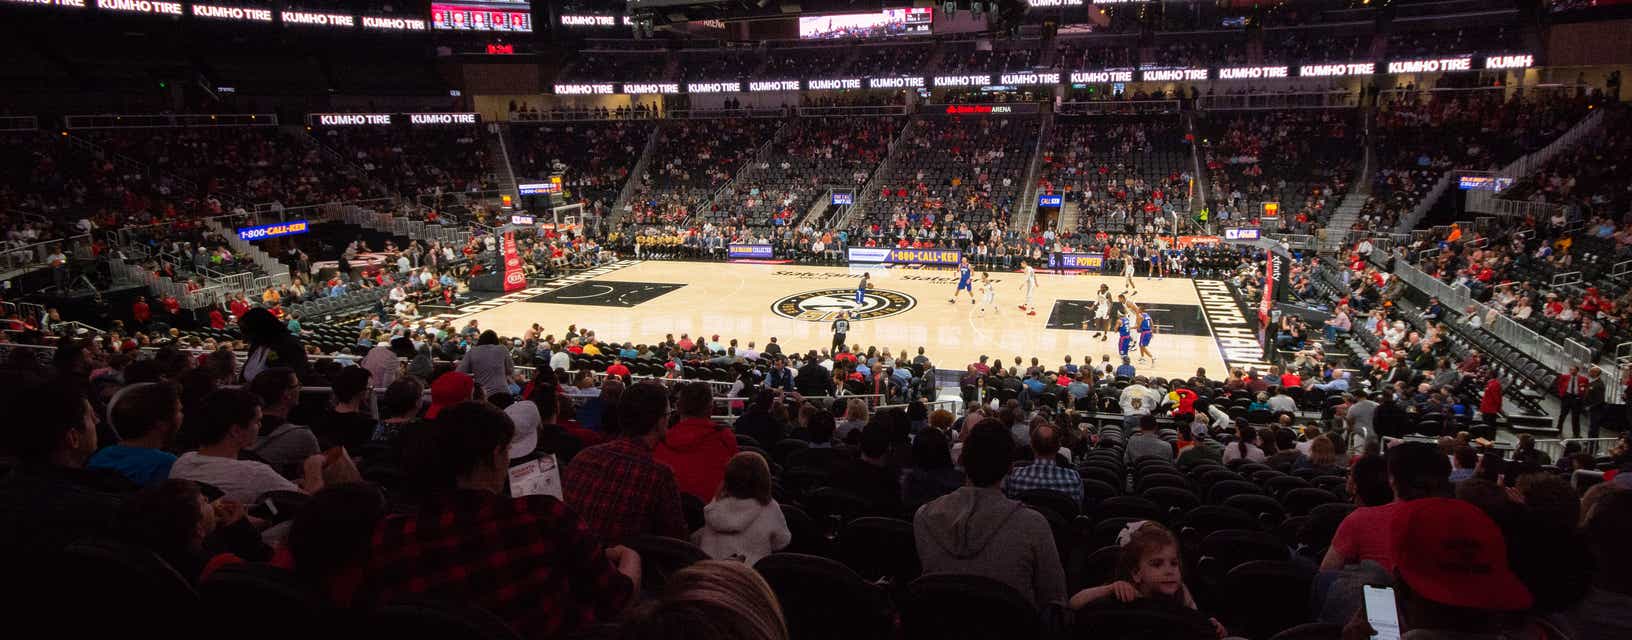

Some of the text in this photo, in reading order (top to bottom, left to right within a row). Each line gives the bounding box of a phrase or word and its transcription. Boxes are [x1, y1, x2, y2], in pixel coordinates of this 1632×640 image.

[97, 0, 182, 15] KUMHO TIRE
[192, 5, 272, 21] KUMHO TIRE
[281, 11, 354, 26] KUMHO TIRE
[363, 16, 406, 28] KUMHO
[561, 16, 595, 25] KUMHO
[596, 16, 615, 25] TIRE
[1299, 63, 1375, 77] KUMHO TIRE
[1388, 58, 1472, 74] KUMHO TIRE
[1071, 72, 1132, 82] KUMHO TIRE
[1143, 69, 1208, 81] KUMHO TIRE
[1219, 66, 1288, 79] KUMHO TIRE
[809, 79, 860, 89] KUMHO TIRE
[870, 77, 924, 88] KUMHO TIRE
[934, 76, 990, 86] KUMHO TIRE
[1001, 74, 1059, 85] KUMHO TIRE
[555, 84, 613, 94] KUMHO TIRE
[623, 84, 678, 94] KUMHO TIRE
[688, 83, 740, 92] KUMHO TIRE
[750, 81, 799, 91] KUMHO TIRE
[320, 115, 390, 125] KUMHO TIRE
[411, 114, 475, 124] KUMHO TIRE
[240, 222, 306, 239] 1-800-CALL-KEN
[890, 249, 958, 263] 1-800-CALL-KEN
[1063, 256, 1076, 266] THE
[1076, 257, 1102, 267] POWER
[1271, 255, 1281, 282] xfinity
[510, 273, 522, 283] KIA
